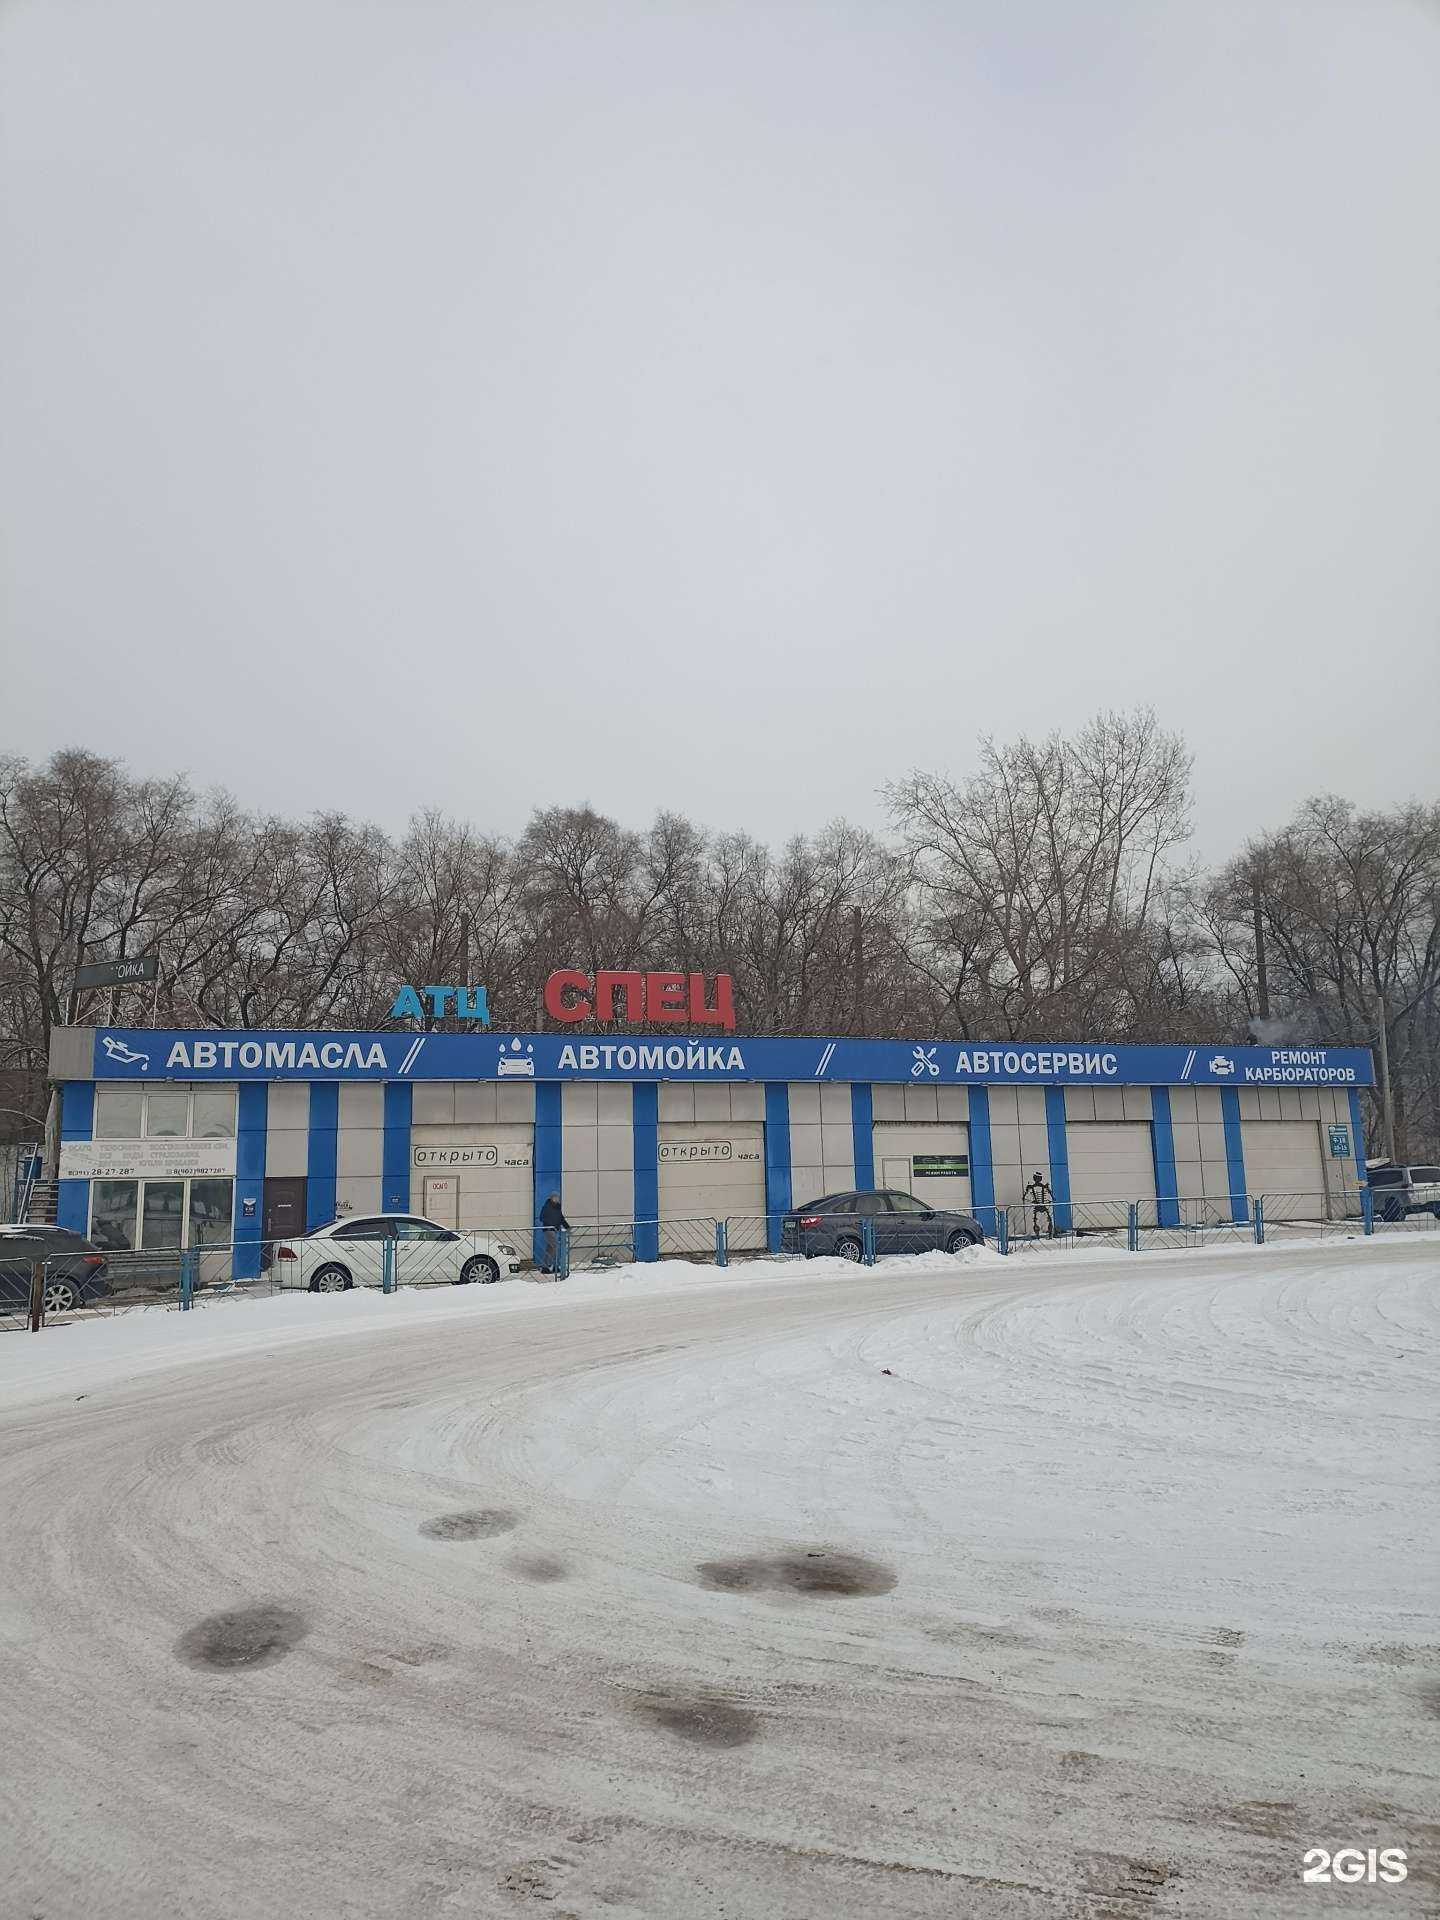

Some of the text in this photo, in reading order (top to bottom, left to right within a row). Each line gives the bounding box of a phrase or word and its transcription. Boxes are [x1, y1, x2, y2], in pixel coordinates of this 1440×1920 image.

[391, 985, 489, 1025] АТЦ
[544, 969, 736, 1029] СПЕЦ
[165, 1041, 388, 1070] АВТОМАСЛА
[558, 1040, 745, 1071] АВТОМОЙКА
[955, 1051, 1118, 1075] АВТОСЕРВИС
[1271, 1051, 1327, 1065] РЕМОНТ
[1245, 1067, 1356, 1081] КАРБЮРАТОРОВ
